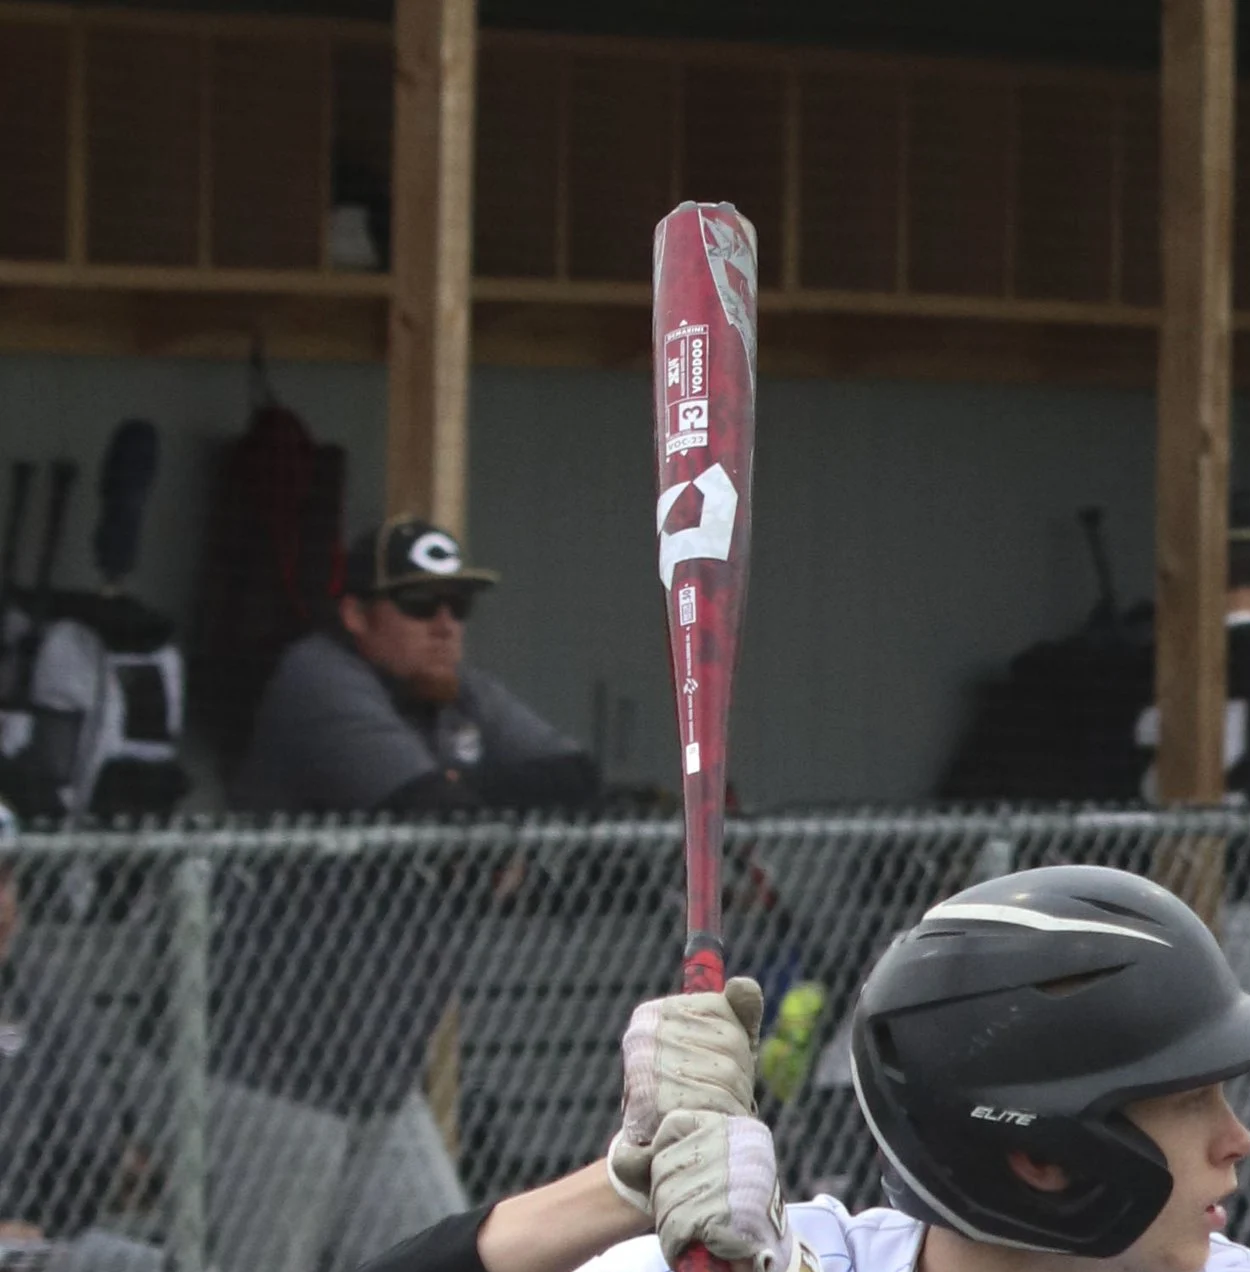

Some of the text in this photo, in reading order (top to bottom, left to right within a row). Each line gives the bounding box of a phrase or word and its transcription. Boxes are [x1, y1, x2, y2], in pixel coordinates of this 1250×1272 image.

[691, 338, 704, 394] VOODOO
[408, 531, 462, 576] C
[970, 1105, 1037, 1126] ELITE
